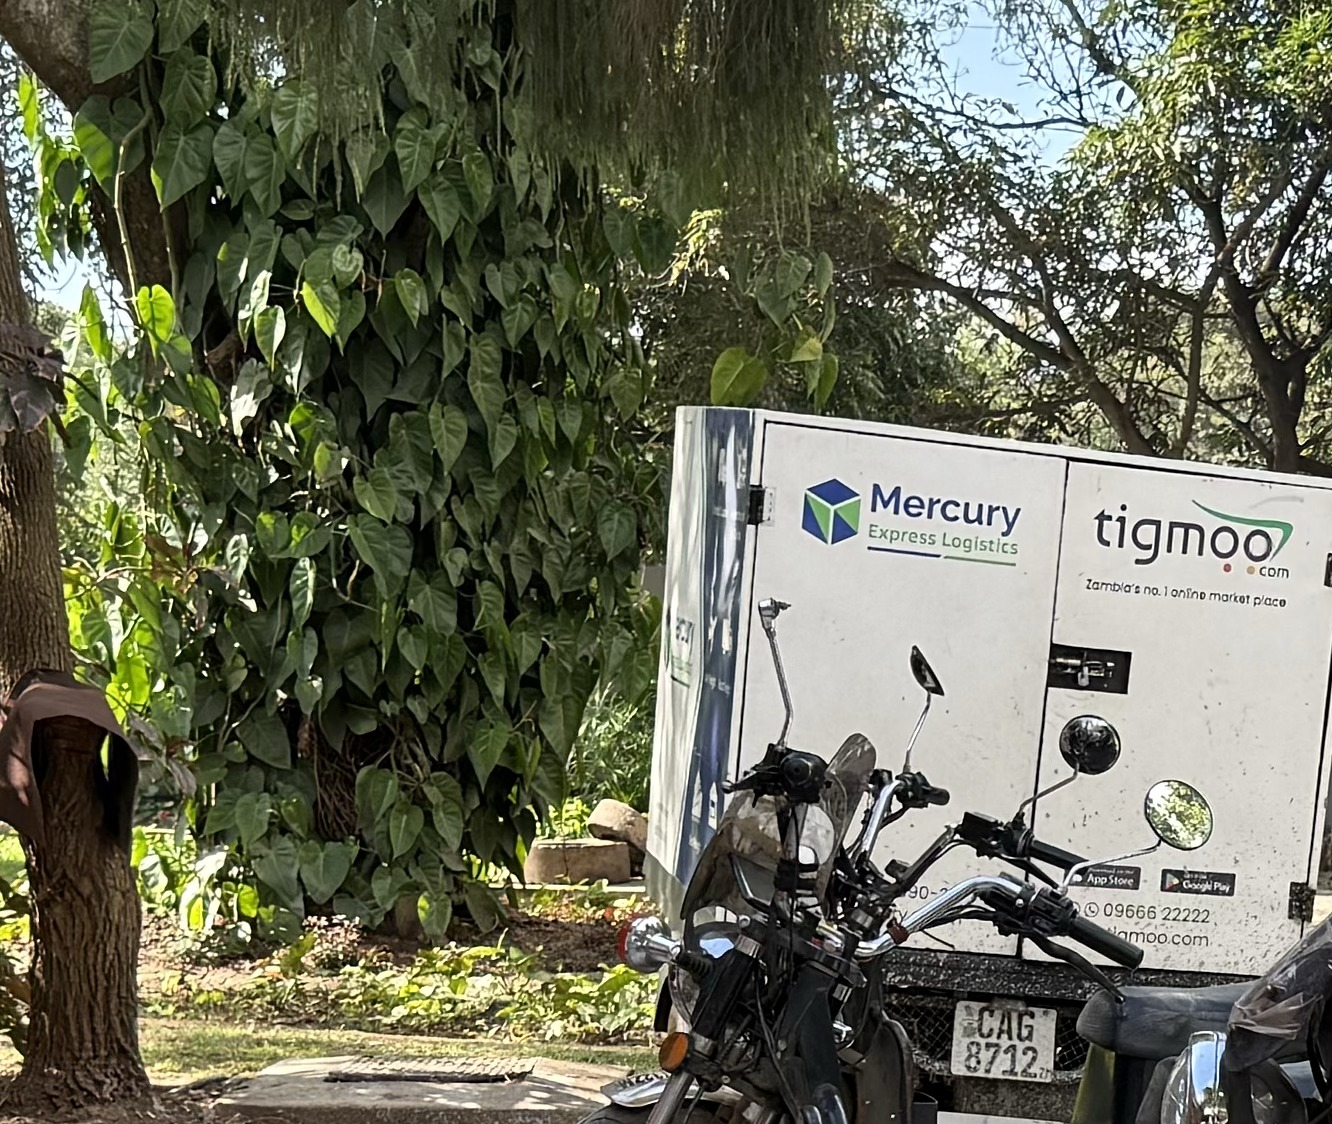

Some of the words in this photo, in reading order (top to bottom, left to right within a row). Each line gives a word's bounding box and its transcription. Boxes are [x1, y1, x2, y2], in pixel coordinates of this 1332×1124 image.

[870, 483, 1021, 537] Mercury
[868, 524, 937, 545] Express
[942, 532, 1019, 555] Logistics
[1094, 503, 1273, 565] tigmoo
[1086, 578, 1140, 594] Zambia's
[1143, 586, 1161, 597] no.
[1209, 591, 1251, 605] market
[1087, 873, 1108, 886] App
[1109, 874, 1135, 886] Store
[1182, 880, 1212, 893] Google
[1214, 881, 1231, 894] Play
[1103, 902, 1157, 920] 09666
[1160, 906, 1210, 923] 22222
[977, 1006, 1035, 1042] CAG
[964, 1041, 1039, 1078] 8712
